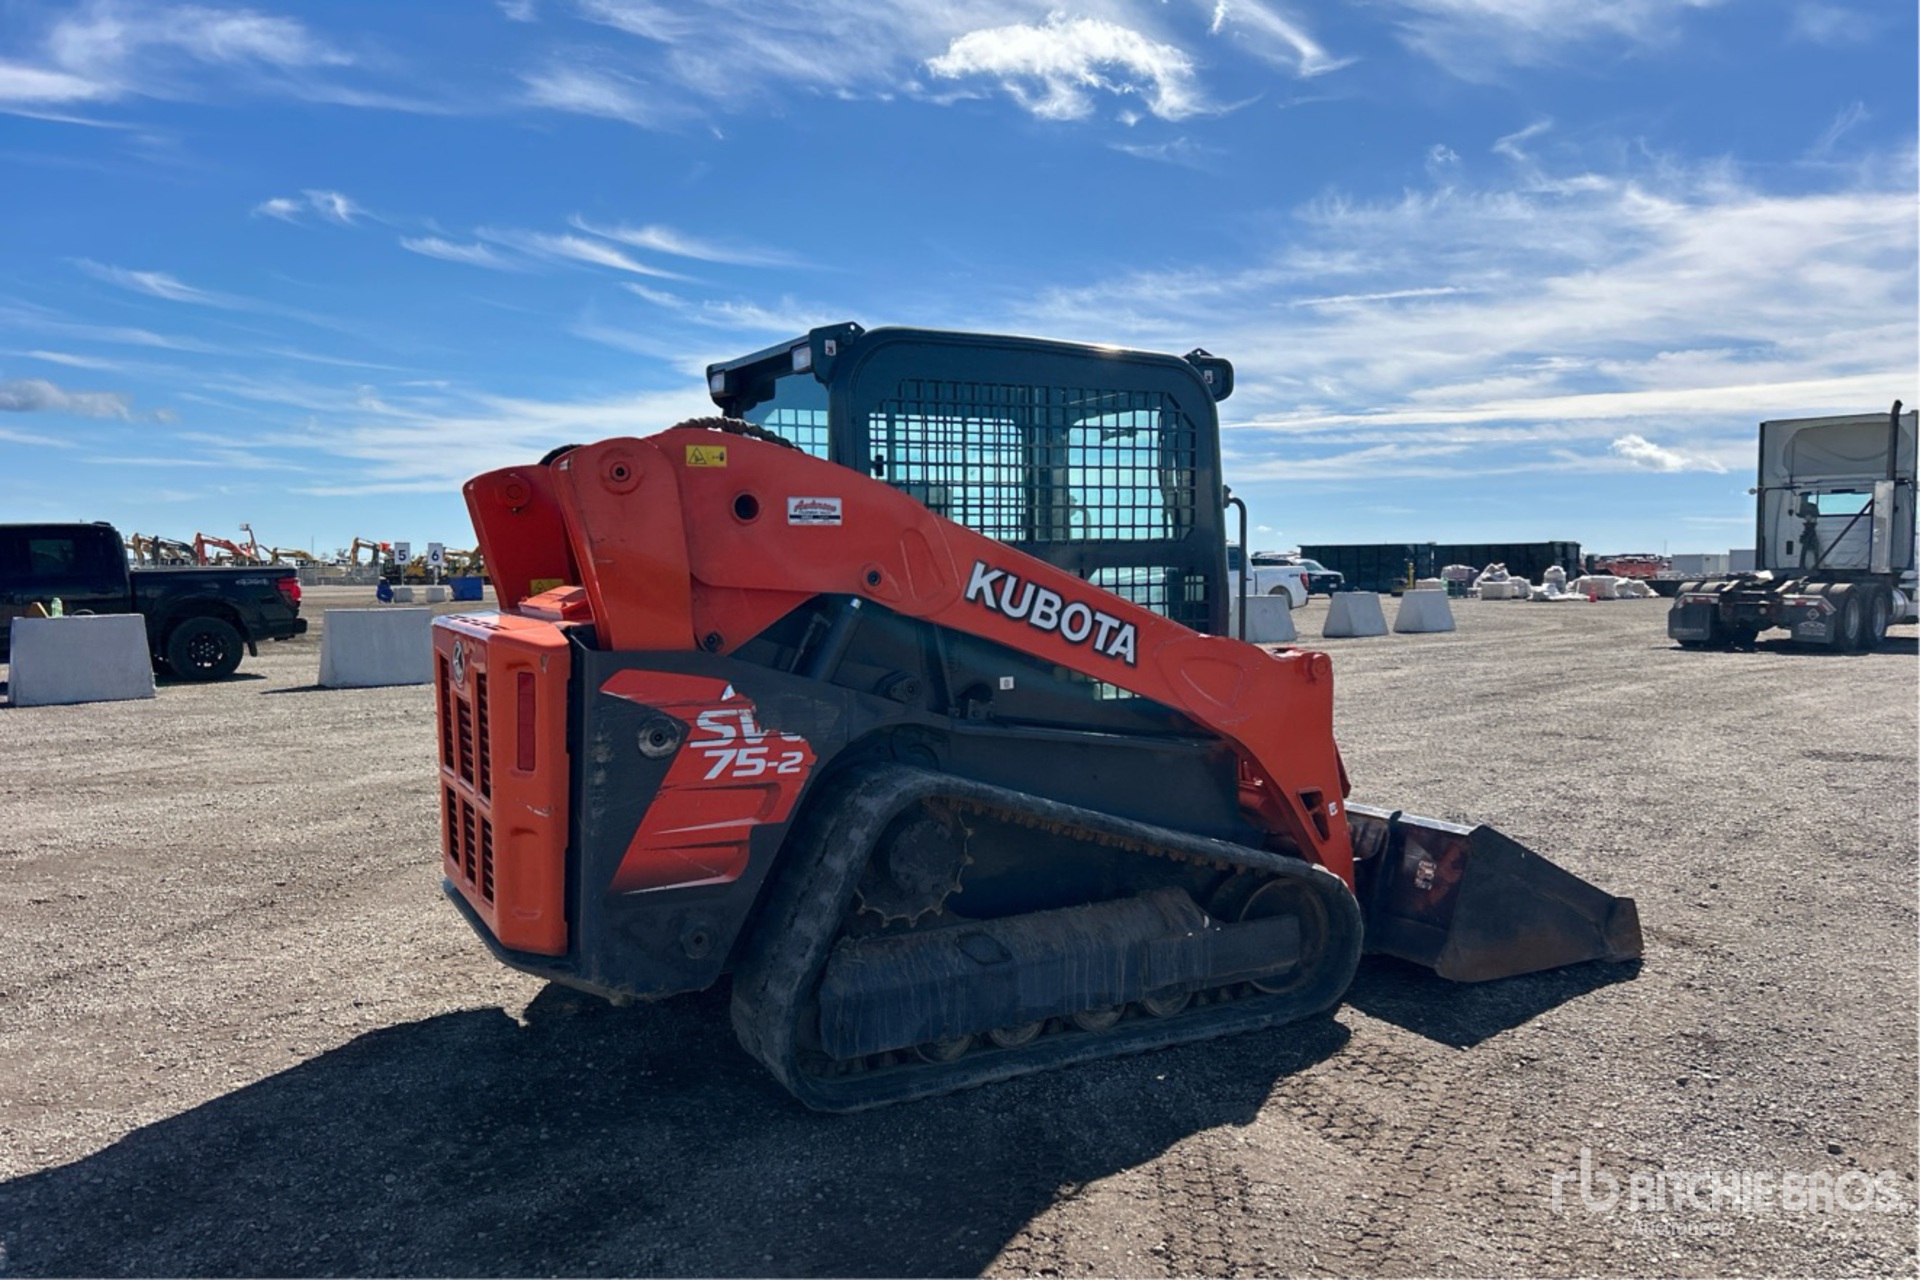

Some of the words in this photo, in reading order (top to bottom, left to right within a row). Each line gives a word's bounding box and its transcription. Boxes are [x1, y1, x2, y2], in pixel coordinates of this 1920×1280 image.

[398, 549, 407, 561] 5
[431, 549, 440, 561] 6
[965, 560, 1137, 666] KUBOTA
[703, 746, 804, 780] 75-2
